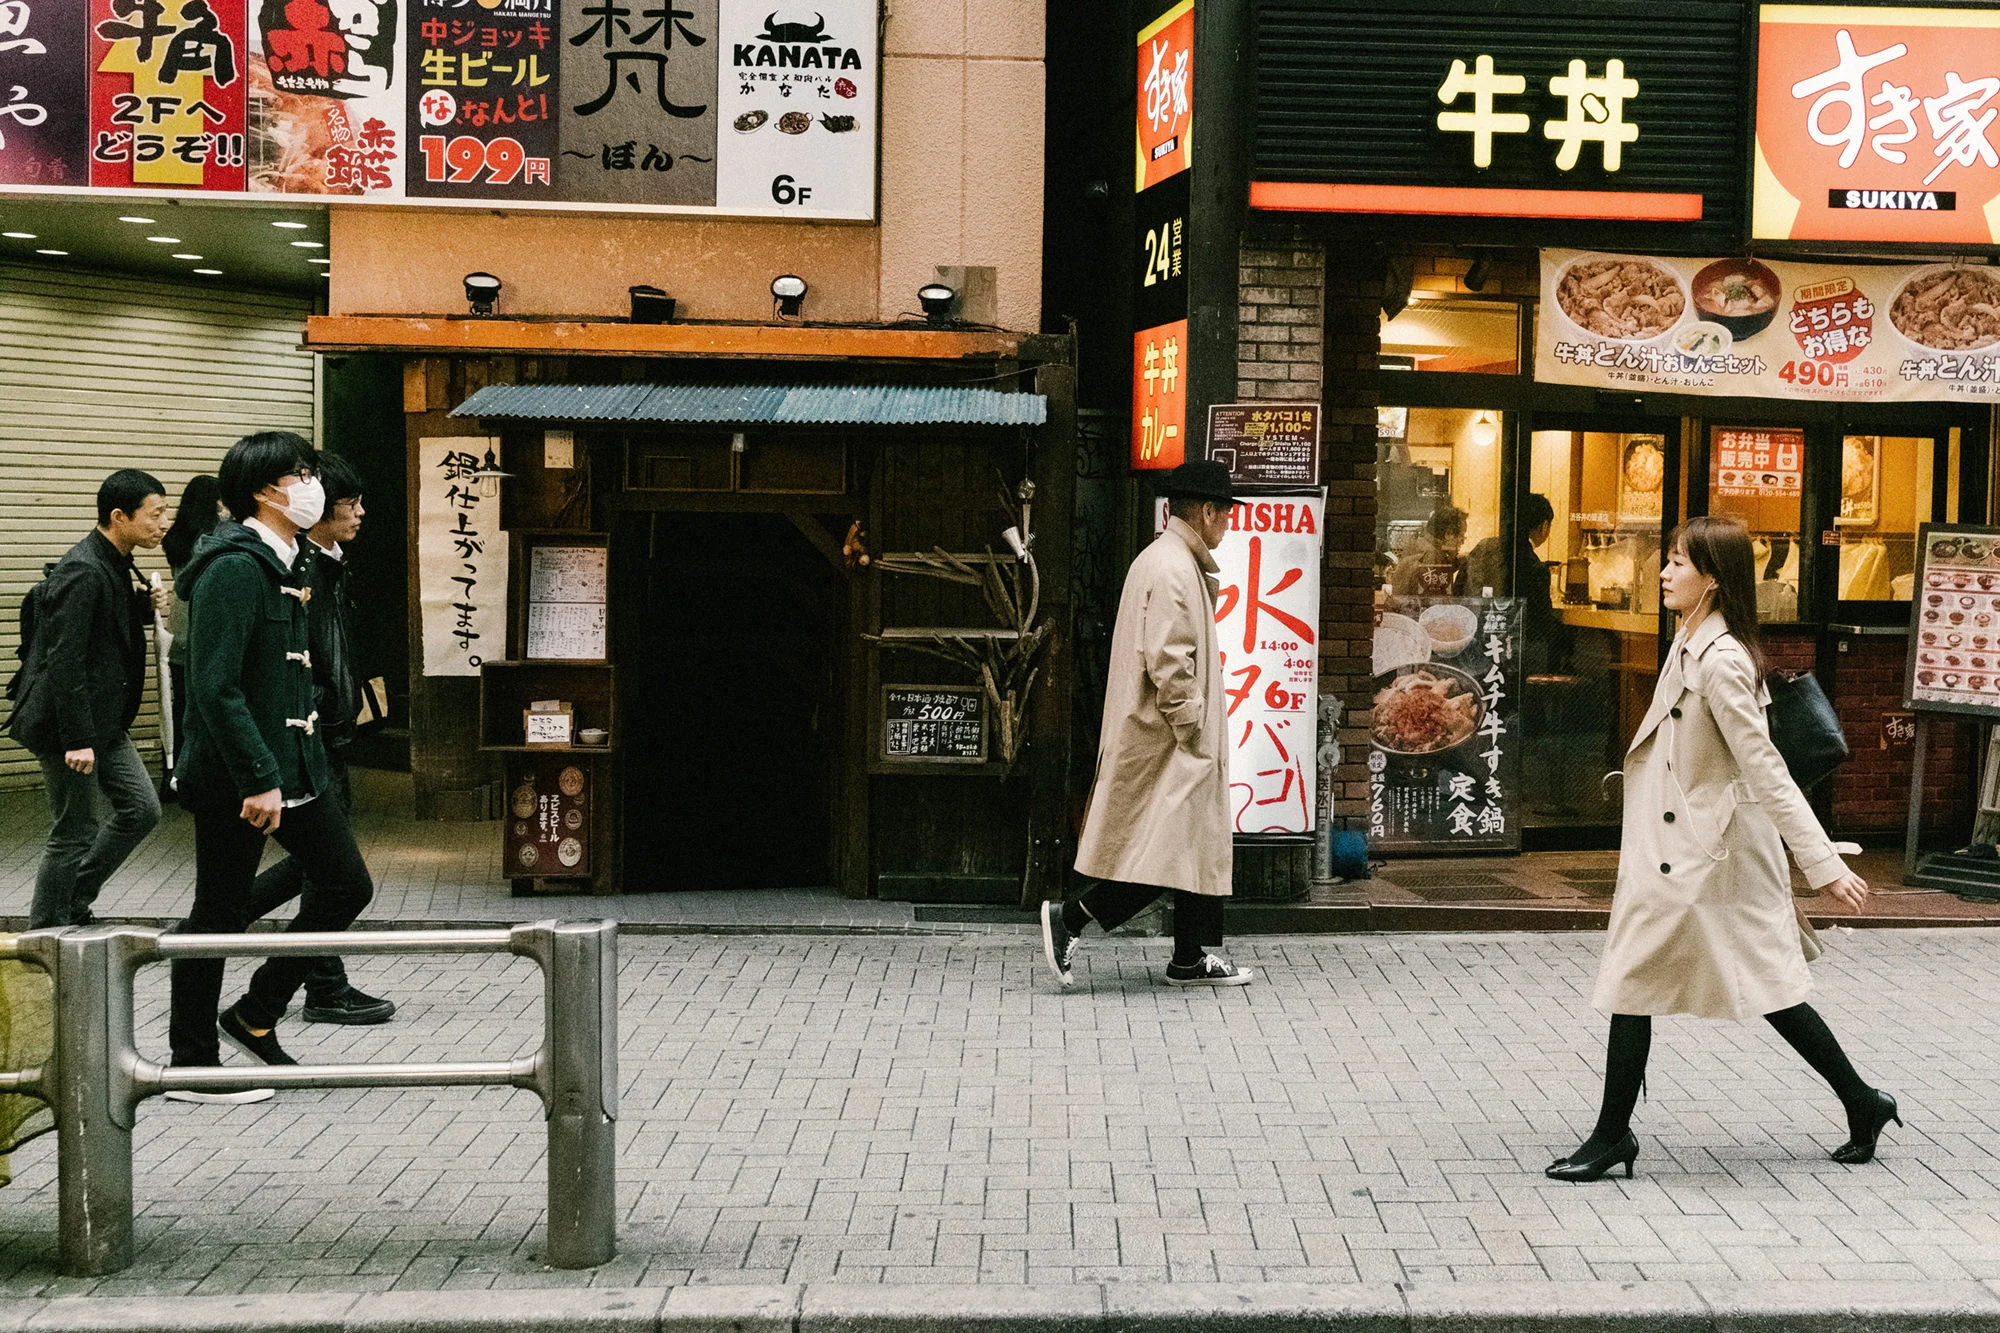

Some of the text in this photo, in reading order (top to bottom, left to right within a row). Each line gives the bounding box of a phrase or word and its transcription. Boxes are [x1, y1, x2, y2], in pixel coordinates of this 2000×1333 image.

[95, 0, 239, 88] 牛角
[421, 17, 550, 50] 中ジョッキ
[420, 48, 551, 88] 生ビール
[569, 0, 707, 118] 梵
[733, 44, 862, 70] KANATA
[1144, 39, 1189, 134] すき家
[112, 94, 226, 126] 2Fへ
[1437, 55, 1639, 171] 牛丼
[1792, 29, 2000, 186] すき家
[94, 131, 244, 167] どうぞ!!
[420, 135, 551, 186] 199円
[771, 175, 812, 206] 6F
[1845, 190, 1938, 210] SUKIYA
[1144, 222, 1170, 287] 24
[1172, 217, 1182, 277] 営業
[1800, 280, 1848, 300] 期間限定
[1789, 297, 1875, 334] どちらも
[1803, 325, 1872, 358] お得な
[1144, 336, 1178, 396] 牛丼
[1554, 342, 1768, 375] 牛丼とん汁おしんこセット
[1778, 360, 1849, 388] 490円
[1899, 355, 2000, 383] 牛丼とん汁
[1251, 410, 1313, 422] 水タバコ1台
[1140, 407, 1178, 461] カレー
[1722, 432, 1770, 451] お弁当
[1720, 450, 1770, 469] 販売中
[1422, 566, 1449, 585] すき家
[1260, 640, 1298, 651] 14:00
[1283, 658, 1314, 669] 4:00
[918, 703, 965, 720] 500円
[1264, 680, 1307, 710] 6F
[1477, 634, 1507, 835] キムチ牛すき鍋
[1317, 777, 1331, 820] 送水口
[1370, 783, 1385, 838] 760円
[1446, 771, 1478, 836] 定食
